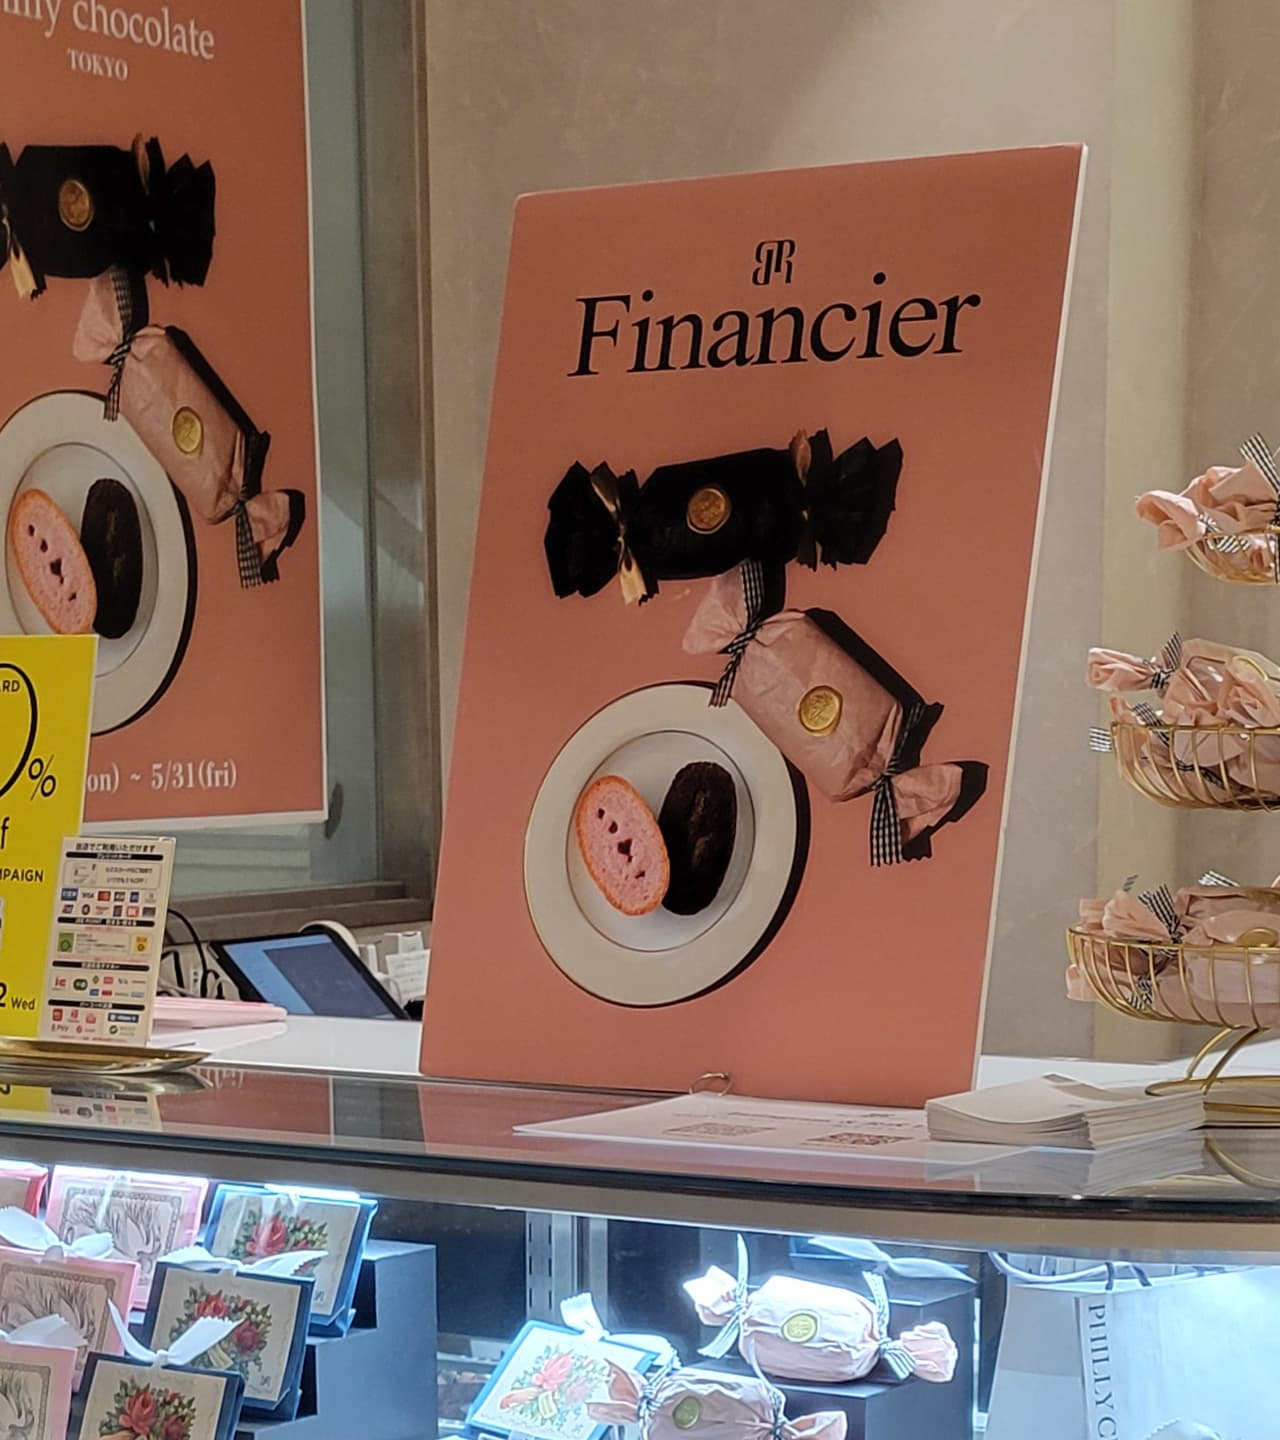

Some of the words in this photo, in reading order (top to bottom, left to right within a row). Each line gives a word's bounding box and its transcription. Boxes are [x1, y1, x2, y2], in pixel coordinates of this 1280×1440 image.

[72, 0, 215, 60] chocolate
[67, 48, 128, 81] TOKYO
[567, 272, 981, 377] Financier
[151, 759, 237, 792] 5/31(fri)
[11, 997, 36, 1010] Wed
[1088, 1304, 1114, 1410] PHILLY
